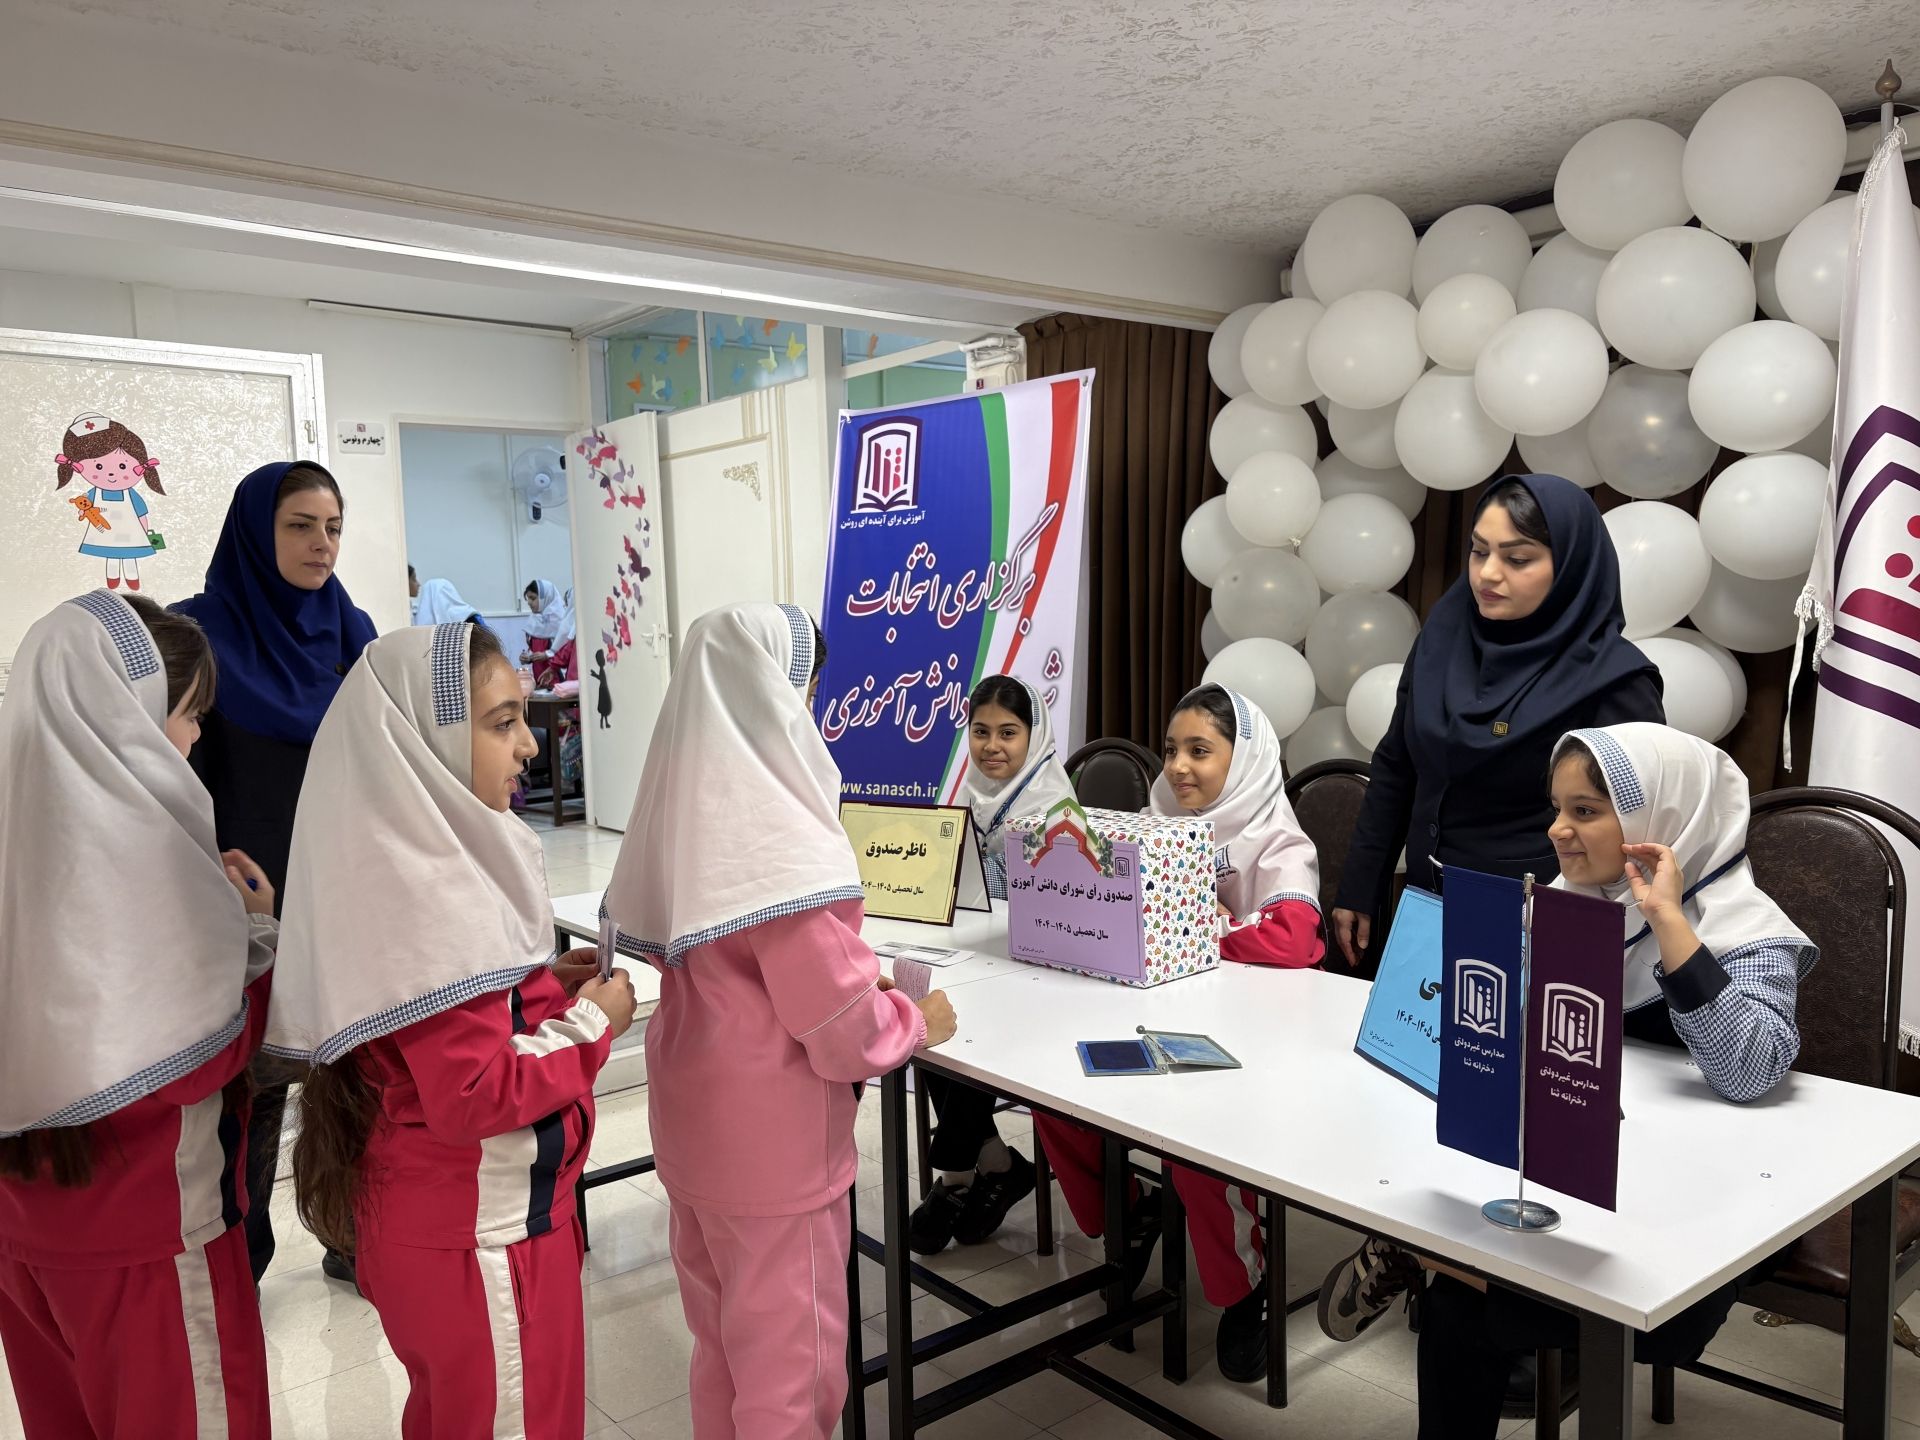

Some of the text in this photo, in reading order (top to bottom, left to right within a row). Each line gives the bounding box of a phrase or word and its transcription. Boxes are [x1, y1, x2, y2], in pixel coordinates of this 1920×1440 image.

[840, 510, 926, 530] آموزش برای آینده ای روشن
[846, 502, 1059, 643] برگزاری انتخابات
[821, 670, 923, 742] آموزی
[904, 653, 969, 743] دانش
[840, 781, 939, 798] ww.sanasch.ir
[865, 842, 927, 860] ناظر صندوق
[892, 885, 913, 894] تحصیلی
[913, 886, 924, 895] سال
[1011, 875, 1036, 890] آموزی
[1037, 879, 1058, 892] دانش
[1059, 882, 1085, 898] شورای
[1103, 889, 1133, 903] صندوق
[1073, 926, 1096, 937] تحصیلی
[1097, 929, 1109, 940] سال
[1454, 1037, 1481, 1051] غیردولتی
[1481, 1047, 1505, 1059] مدارس
[1463, 1057, 1495, 1074] دخترانه ثنا
[1539, 1065, 1600, 1091] مدارس غیردولتی
[1550, 1087, 1587, 1107] دخترانه ثنا
